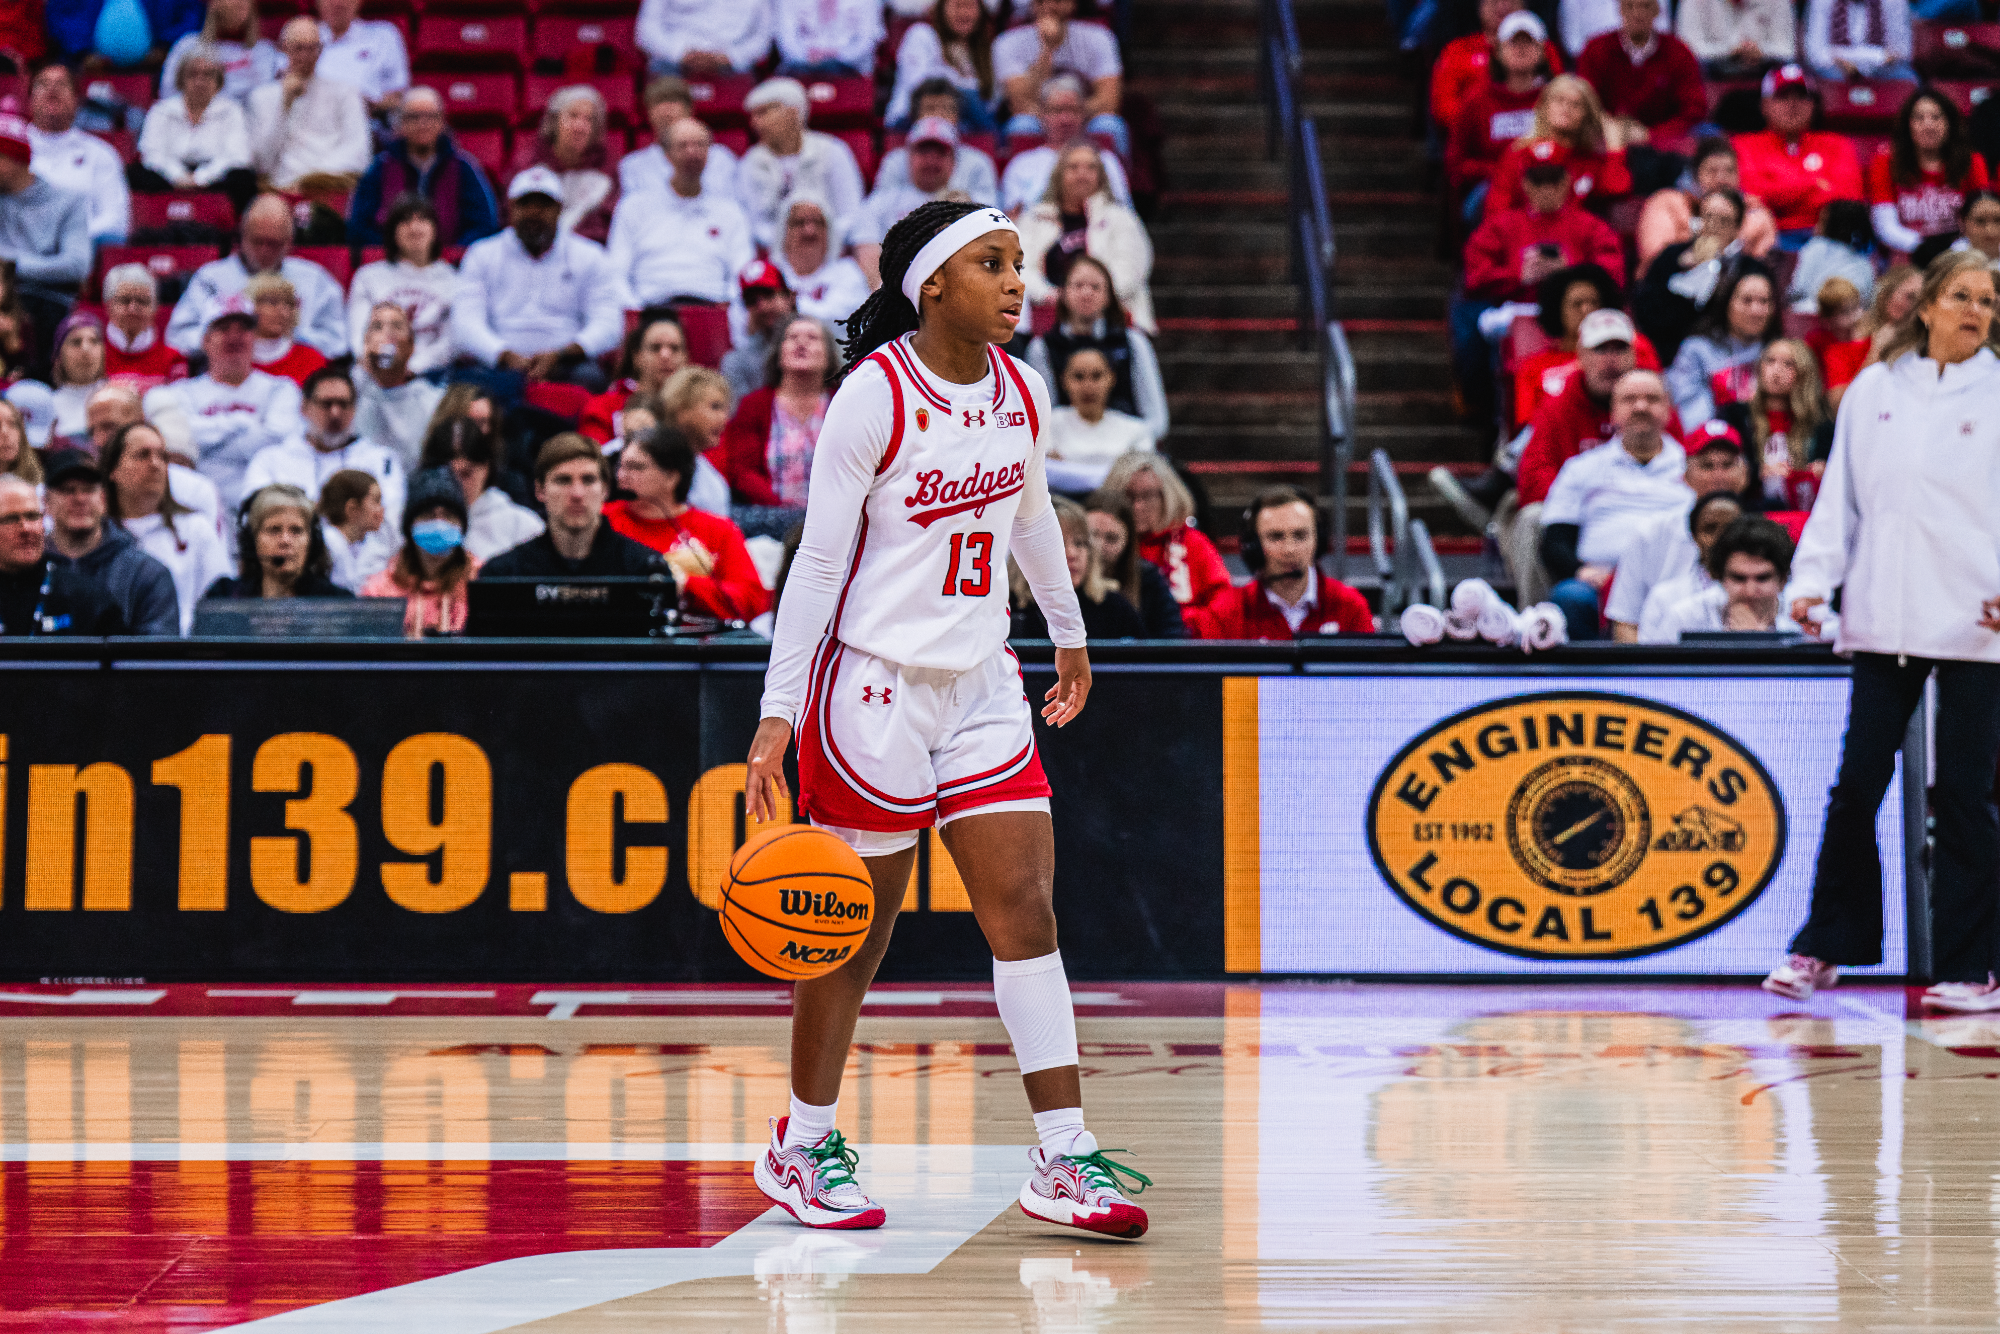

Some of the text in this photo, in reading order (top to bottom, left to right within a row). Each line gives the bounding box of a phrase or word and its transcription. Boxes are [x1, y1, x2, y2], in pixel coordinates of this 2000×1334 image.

[942, 532, 994, 597] 13
[1395, 713, 1748, 812] ENGINEERS
[1414, 822, 1443, 841] EST
[779, 888, 869, 921] Wilson
[1407, 850, 1740, 940] LOCAL 139
[778, 940, 852, 964] NCAA
